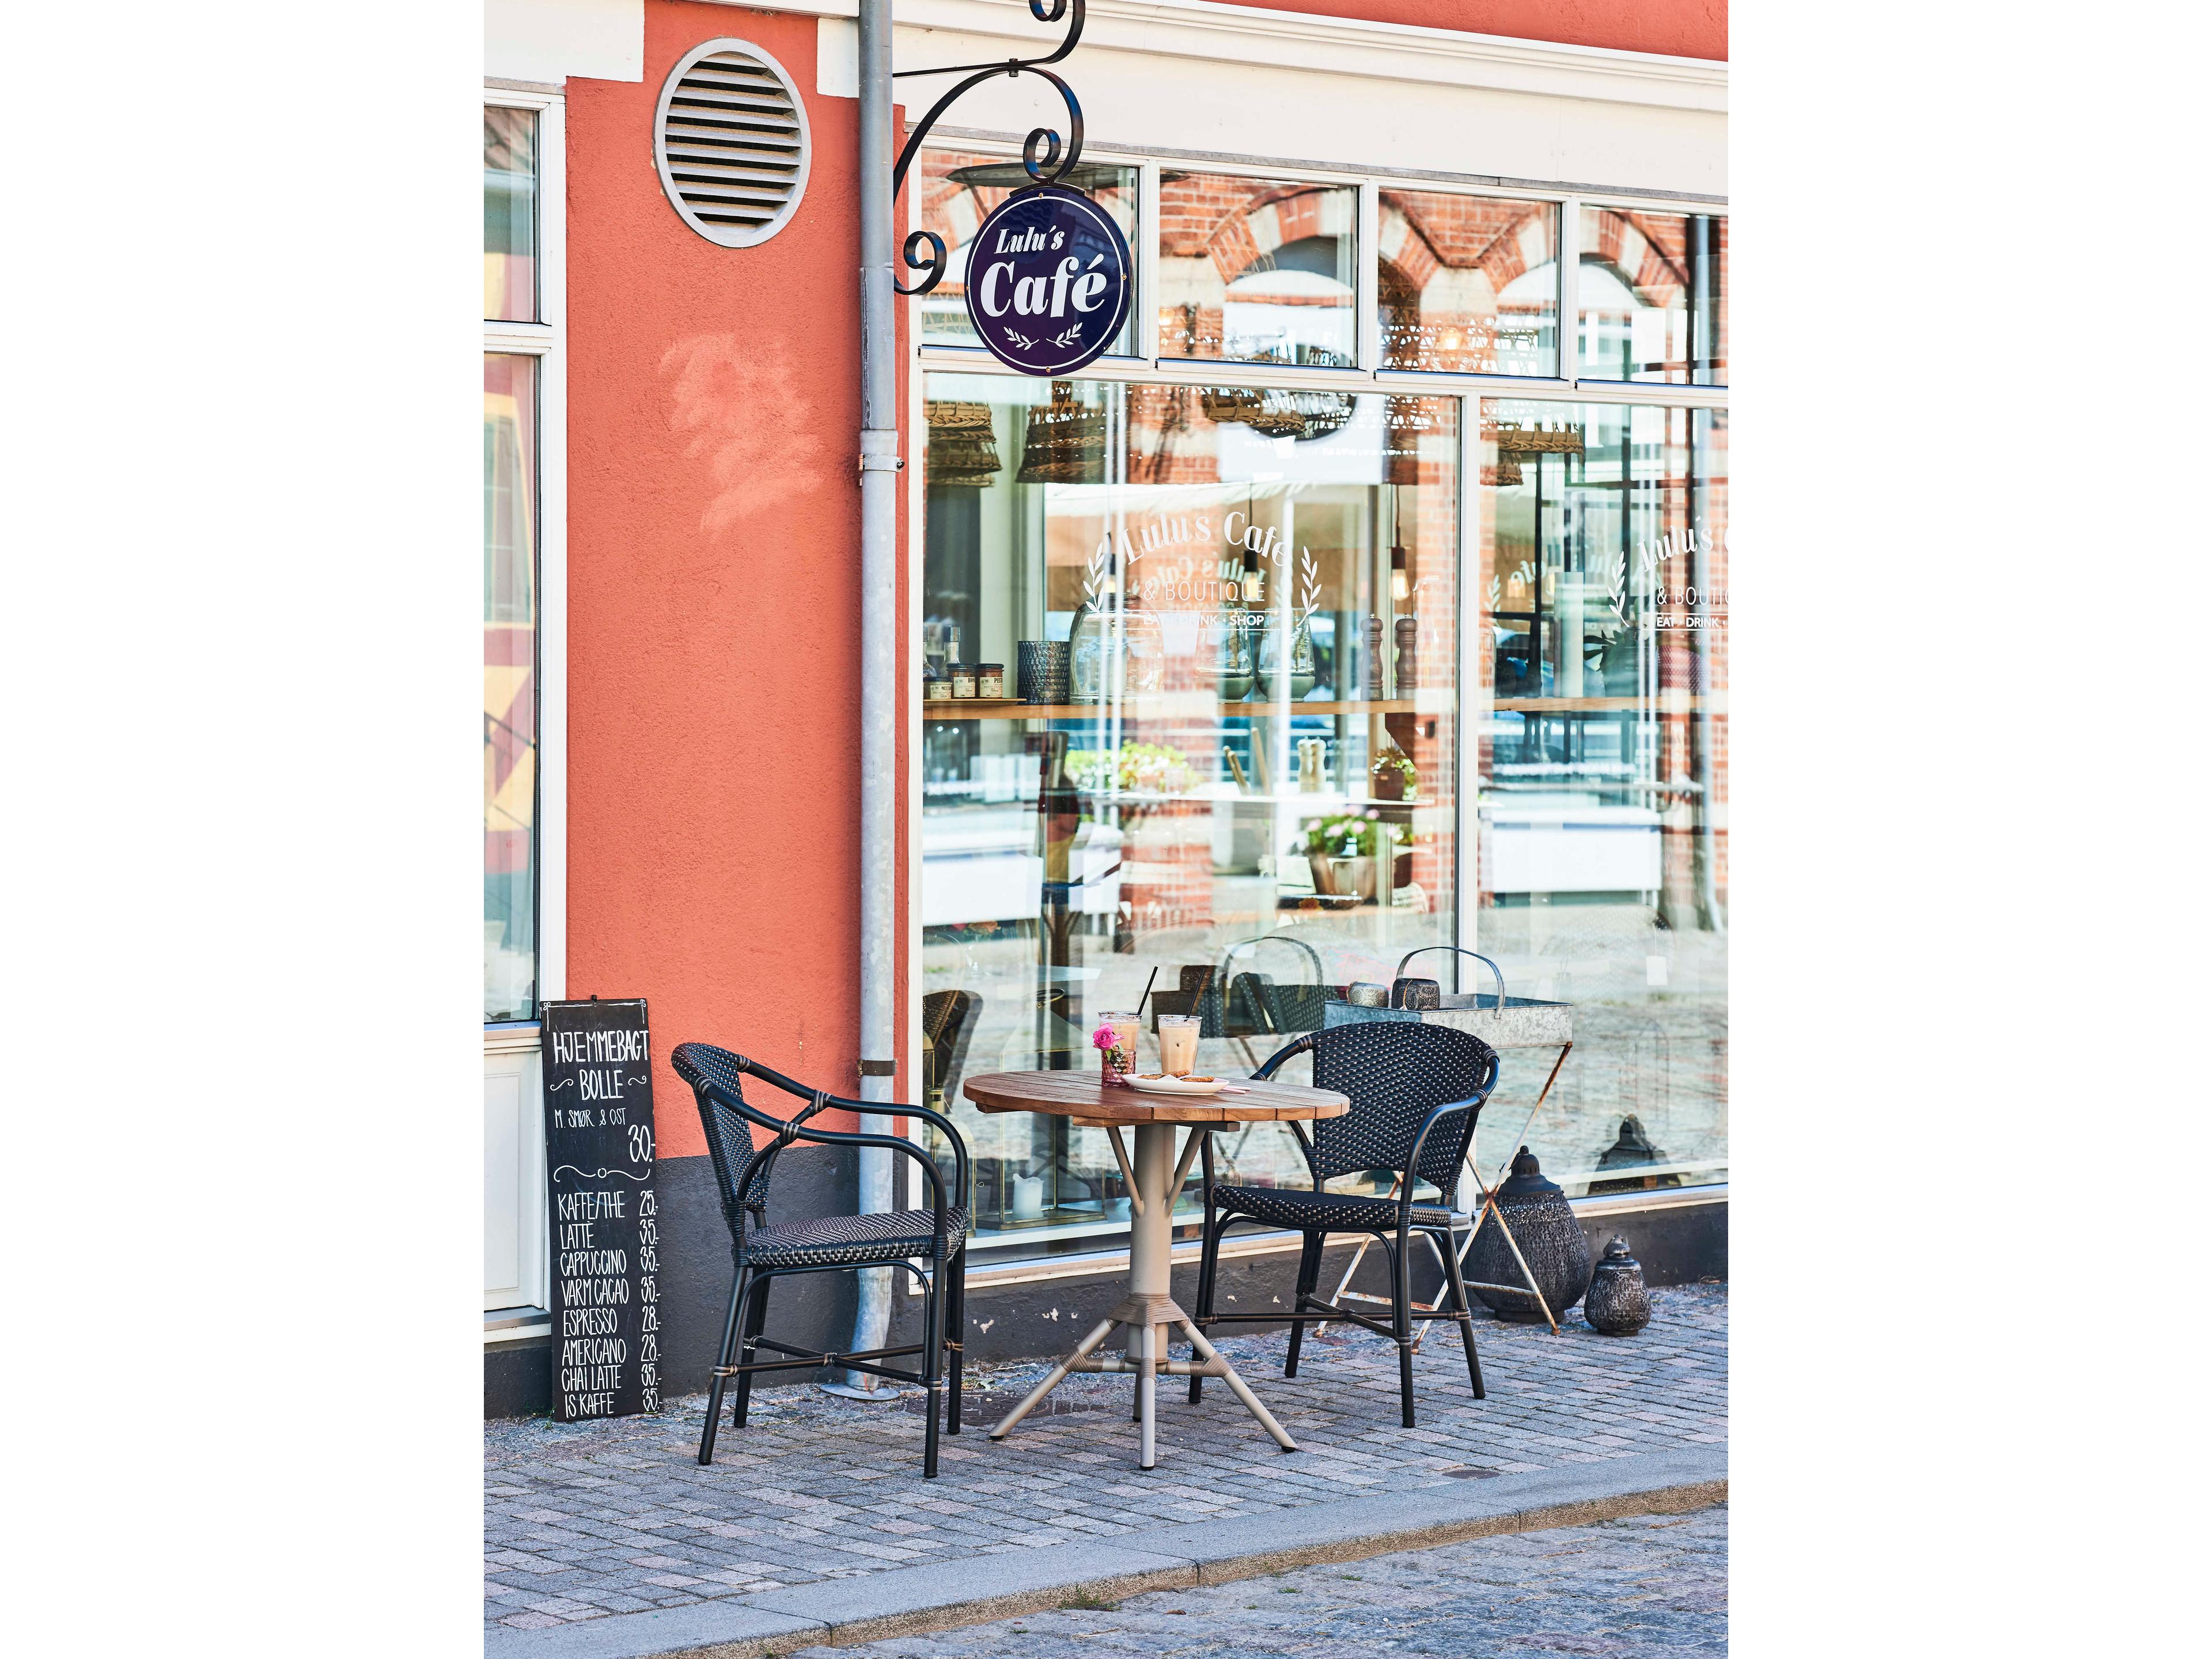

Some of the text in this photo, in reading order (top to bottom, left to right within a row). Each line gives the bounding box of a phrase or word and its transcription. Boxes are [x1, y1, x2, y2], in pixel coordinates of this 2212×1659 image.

[981, 253, 1107, 317] Café
[1143, 581, 1265, 601] & BOUTIQUE
[1657, 586, 1728, 606] & BOUTI
[1229, 615, 1264, 626] SHOP
[1657, 617, 1719, 627] EAT DRINK
[553, 1030, 649, 1063] HJEMMEBAGT
[579, 1069, 624, 1100] BOLLE
[569, 1109, 594, 1127] SMØR
[599, 1109, 606, 1126] &
[610, 1108, 626, 1125] OST
[558, 1191, 625, 1221] KAFFE/THE
[560, 1249, 626, 1277] CAPPUCCINO
[561, 1278, 592, 1306] VARM
[594, 1278, 628, 1305] CACAO
[564, 1308, 617, 1336] ESPRESSO
[562, 1338, 626, 1367] AMERICANO
[562, 1367, 587, 1391] CHAI
[592, 1365, 621, 1390] LATTE
[565, 1395, 576, 1418] IS
[579, 1392, 614, 1415] KAFFE
